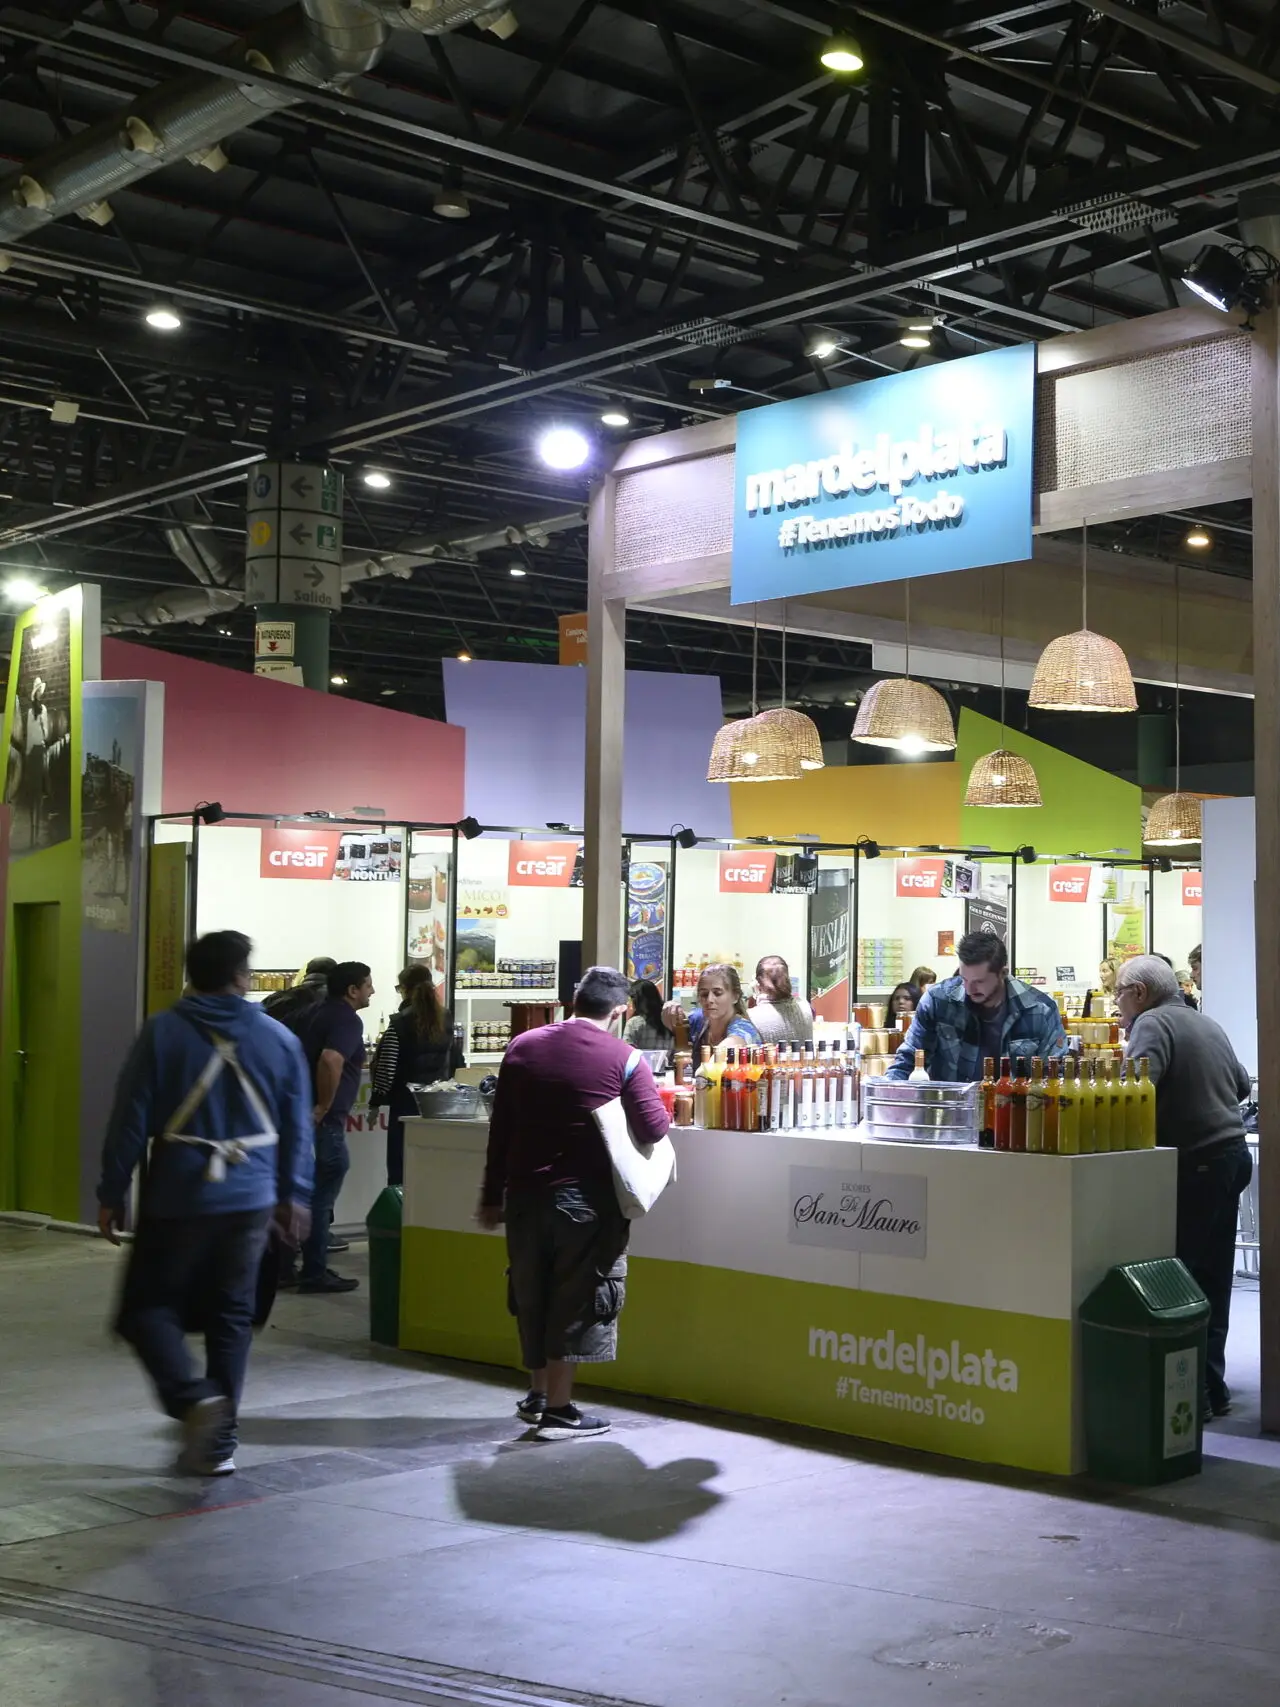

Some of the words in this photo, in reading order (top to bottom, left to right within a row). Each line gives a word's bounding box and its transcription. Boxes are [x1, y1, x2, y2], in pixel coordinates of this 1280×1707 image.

[745, 422, 1007, 513] mardelplata
[778, 490, 964, 551] #TenemosTodo
[269, 850, 329, 868] crear
[516, 860, 567, 877] crear
[725, 868, 767, 883] crear
[901, 874, 938, 888] crear
[1053, 880, 1085, 894] crear
[793, 1192, 841, 1229] San
[841, 1199, 922, 1234] Mauro
[808, 1325, 1018, 1393] mardelplata
[836, 1376, 985, 1426] #TenemosTodo
